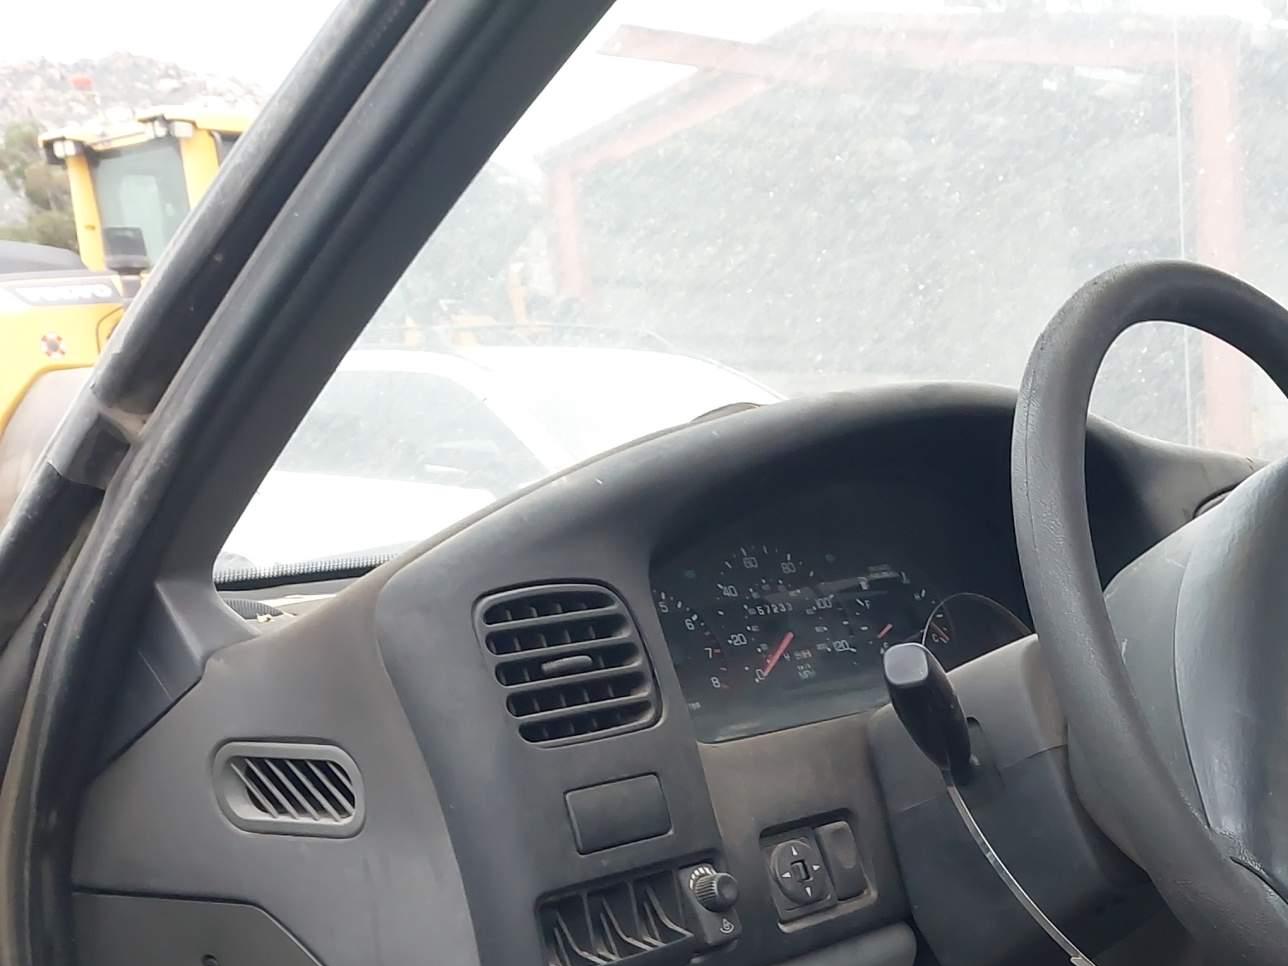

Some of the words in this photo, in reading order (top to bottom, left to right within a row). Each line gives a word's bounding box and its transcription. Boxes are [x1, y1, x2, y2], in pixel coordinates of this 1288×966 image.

[742, 556, 759, 569] 60
[780, 561, 797, 574] 80
[722, 585, 738, 597] 40
[658, 601, 669, 613] 5
[684, 618, 695, 630] 6
[730, 633, 748, 646] 20
[704, 648, 713, 659] 7
[710, 676, 721, 688] 8
